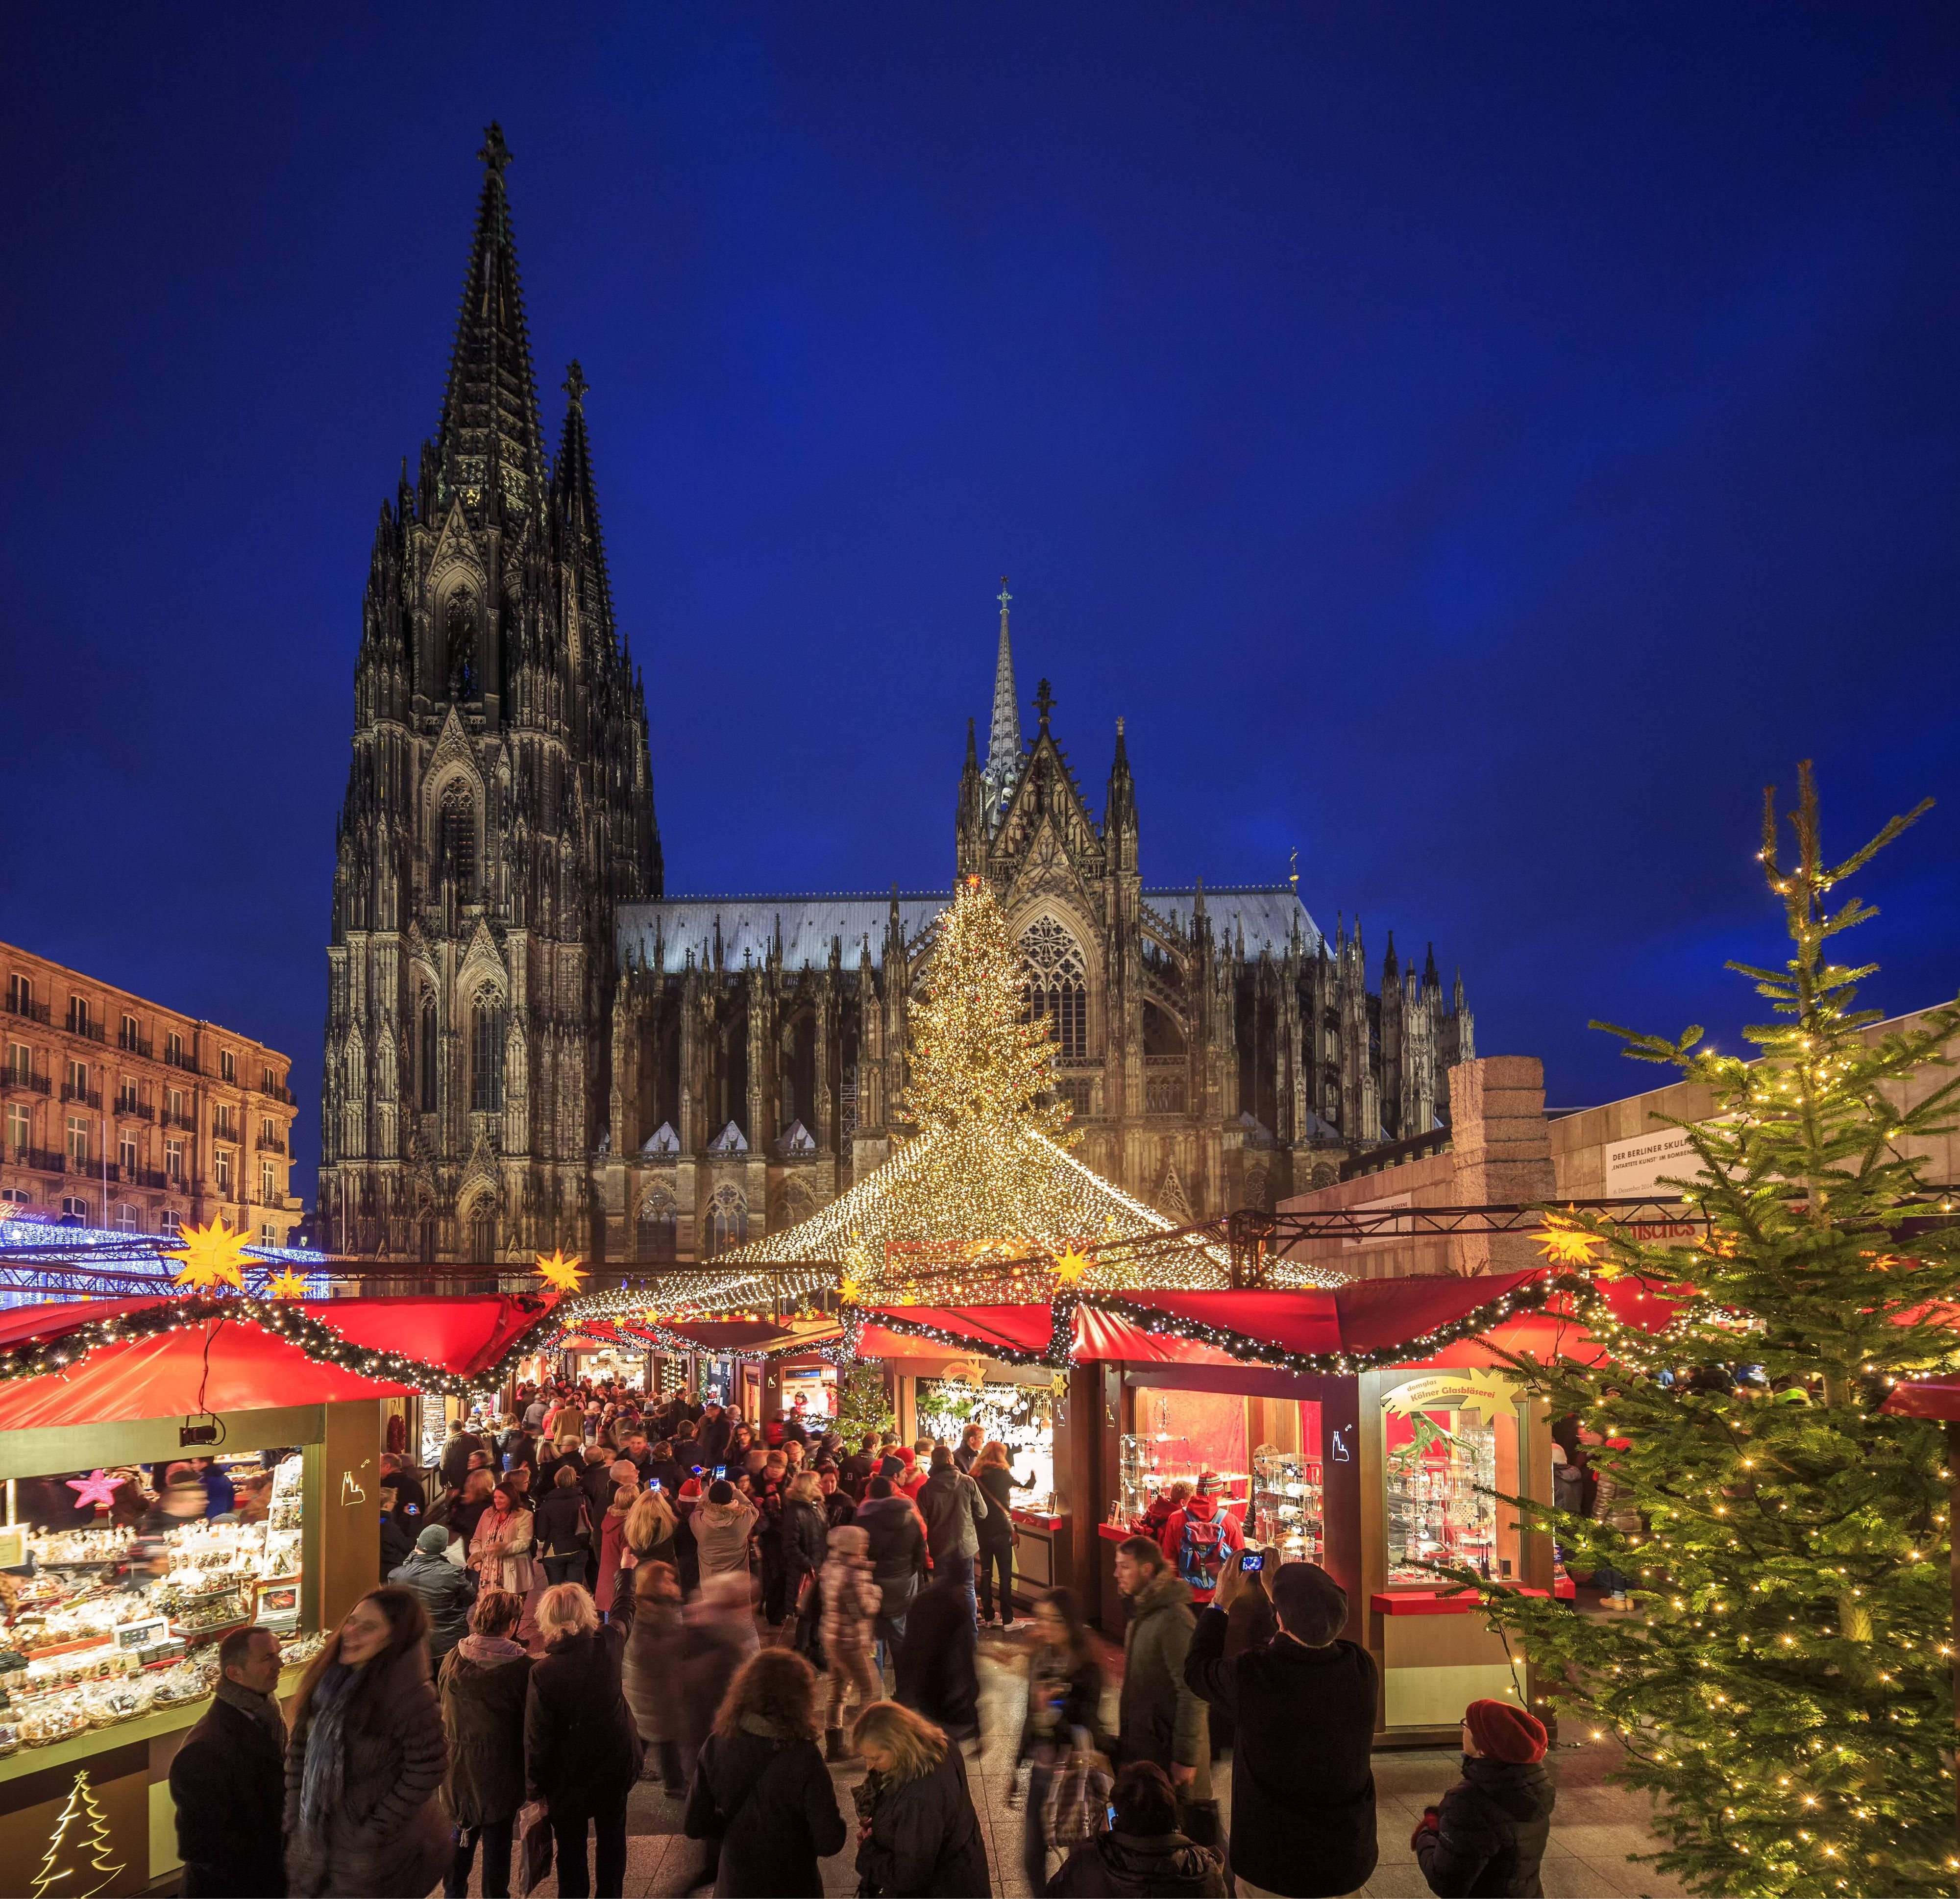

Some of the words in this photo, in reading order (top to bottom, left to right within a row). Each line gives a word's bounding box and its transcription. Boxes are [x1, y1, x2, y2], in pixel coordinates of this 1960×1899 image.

[1613, 1152, 1625, 1160] DER
[1628, 1144, 1662, 1158] BERLINER
[1407, 1380, 1437, 1391] domglas
[1411, 1390, 1439, 1402] Kölner
[1442, 1386, 1495, 1398] Glasbläserei
